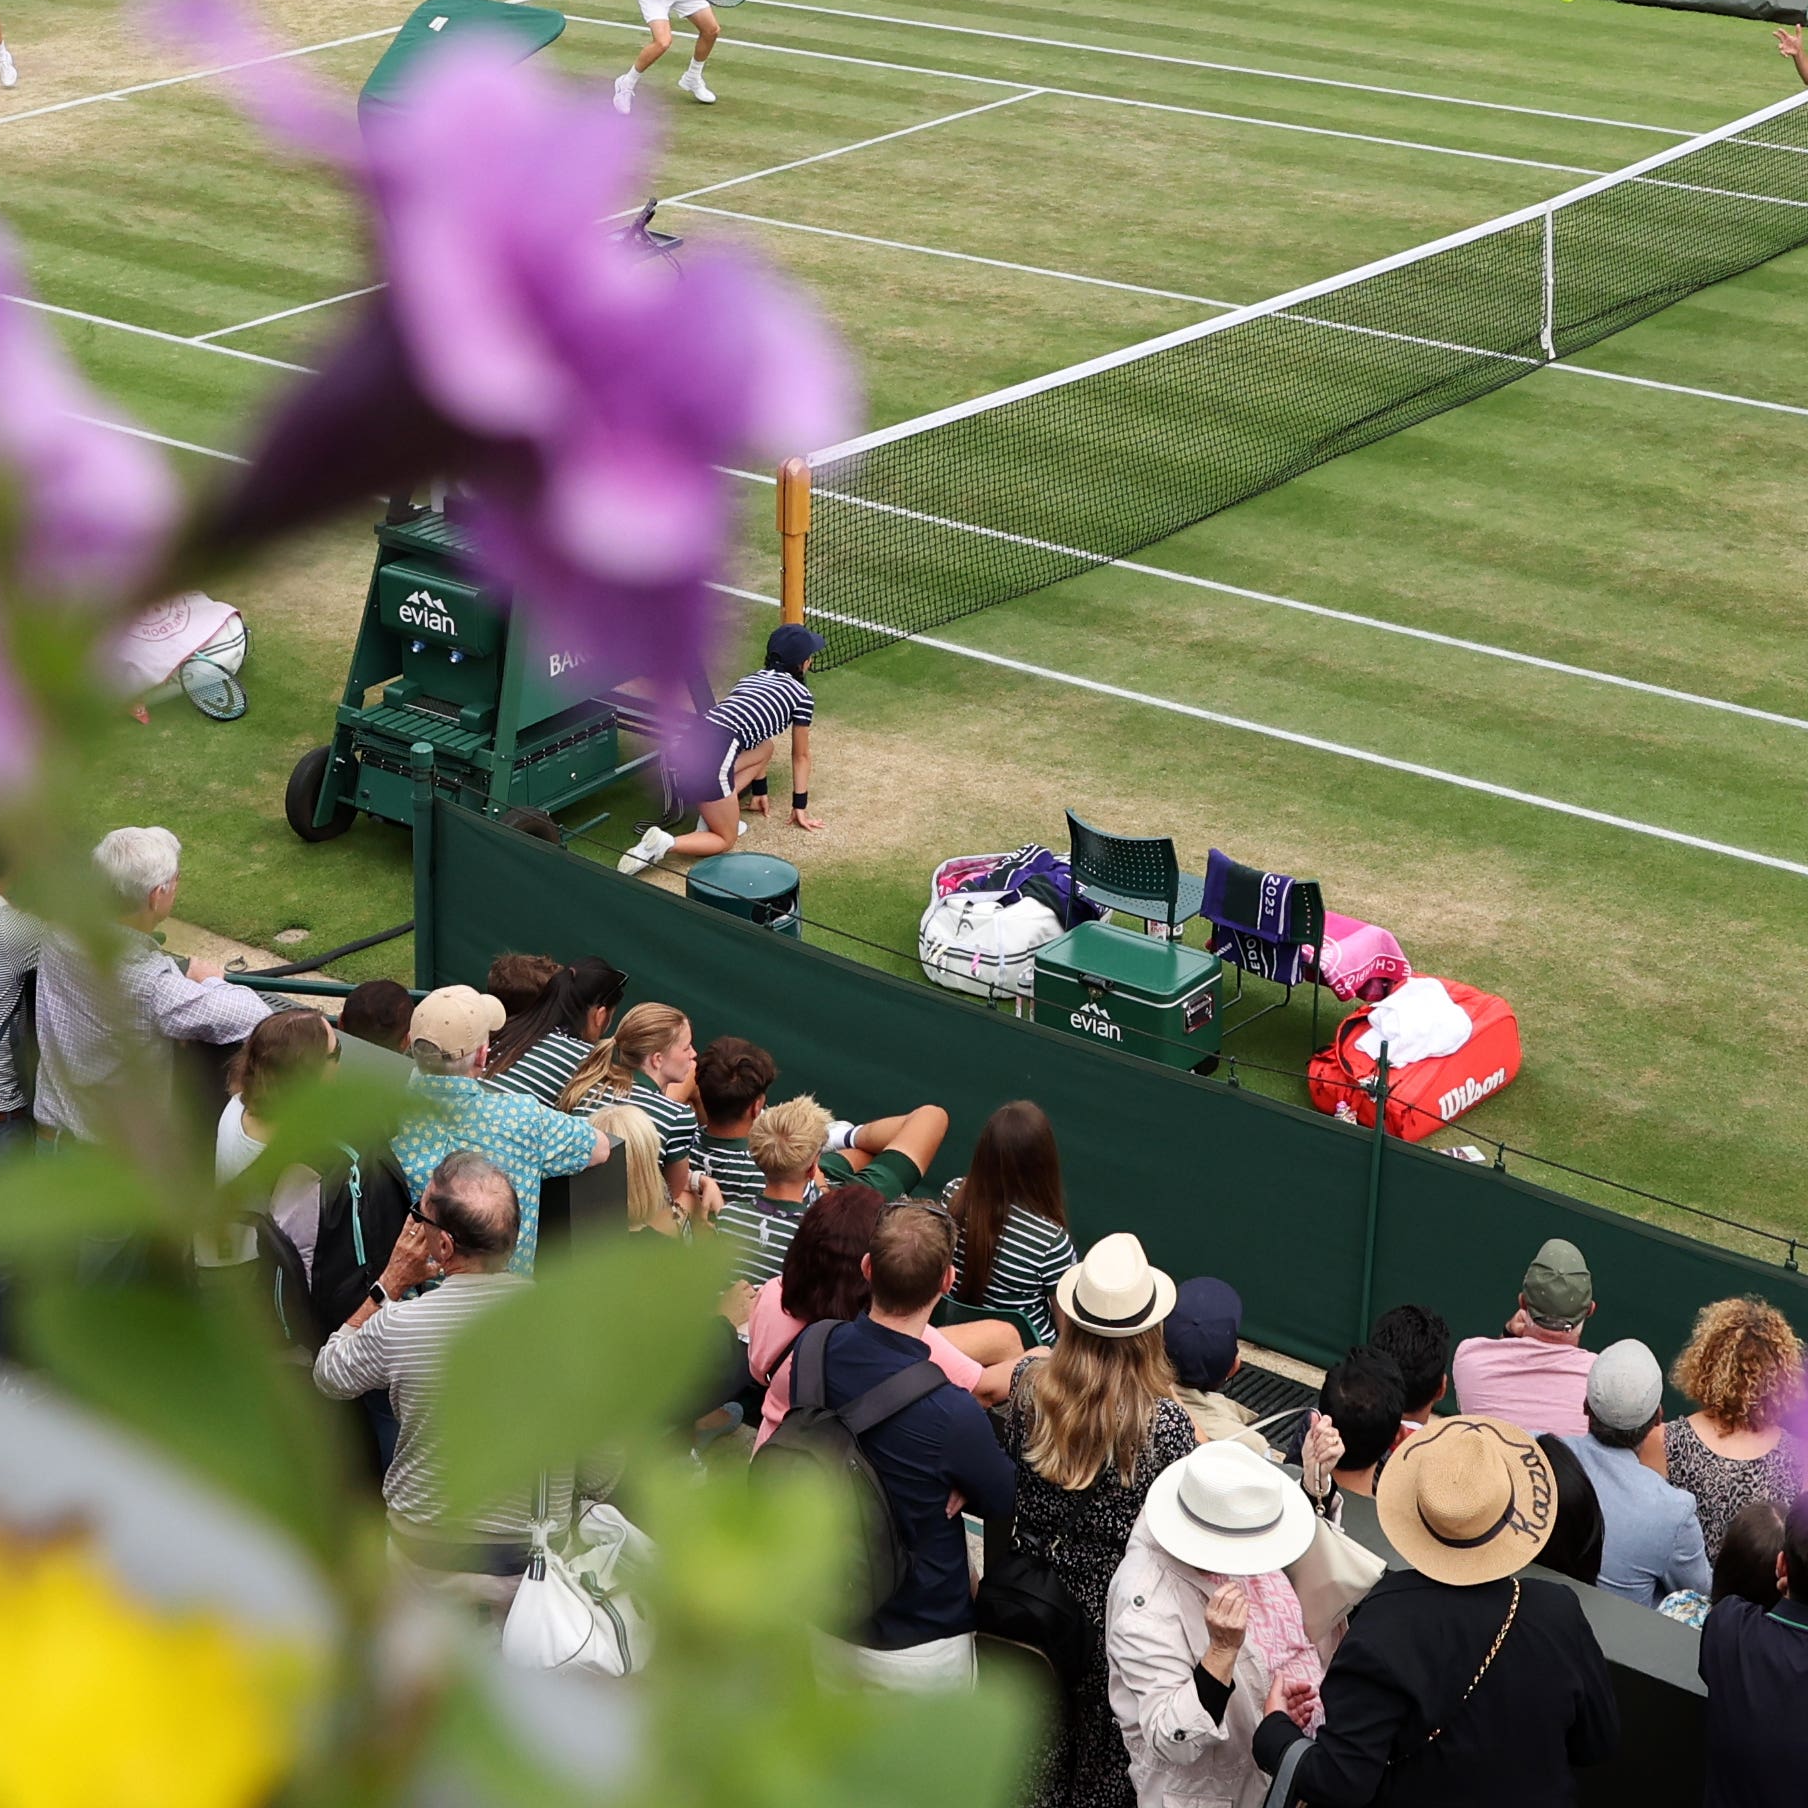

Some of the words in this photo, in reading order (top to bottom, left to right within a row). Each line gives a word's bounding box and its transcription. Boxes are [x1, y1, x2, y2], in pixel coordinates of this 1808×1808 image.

[399, 604, 456, 636] evian
[1264, 874, 1281, 917] 2023
[1070, 1012, 1121, 1042] evian
[1438, 1067, 1505, 1121] Wilson
[1509, 1451, 1552, 1544] Kazza
